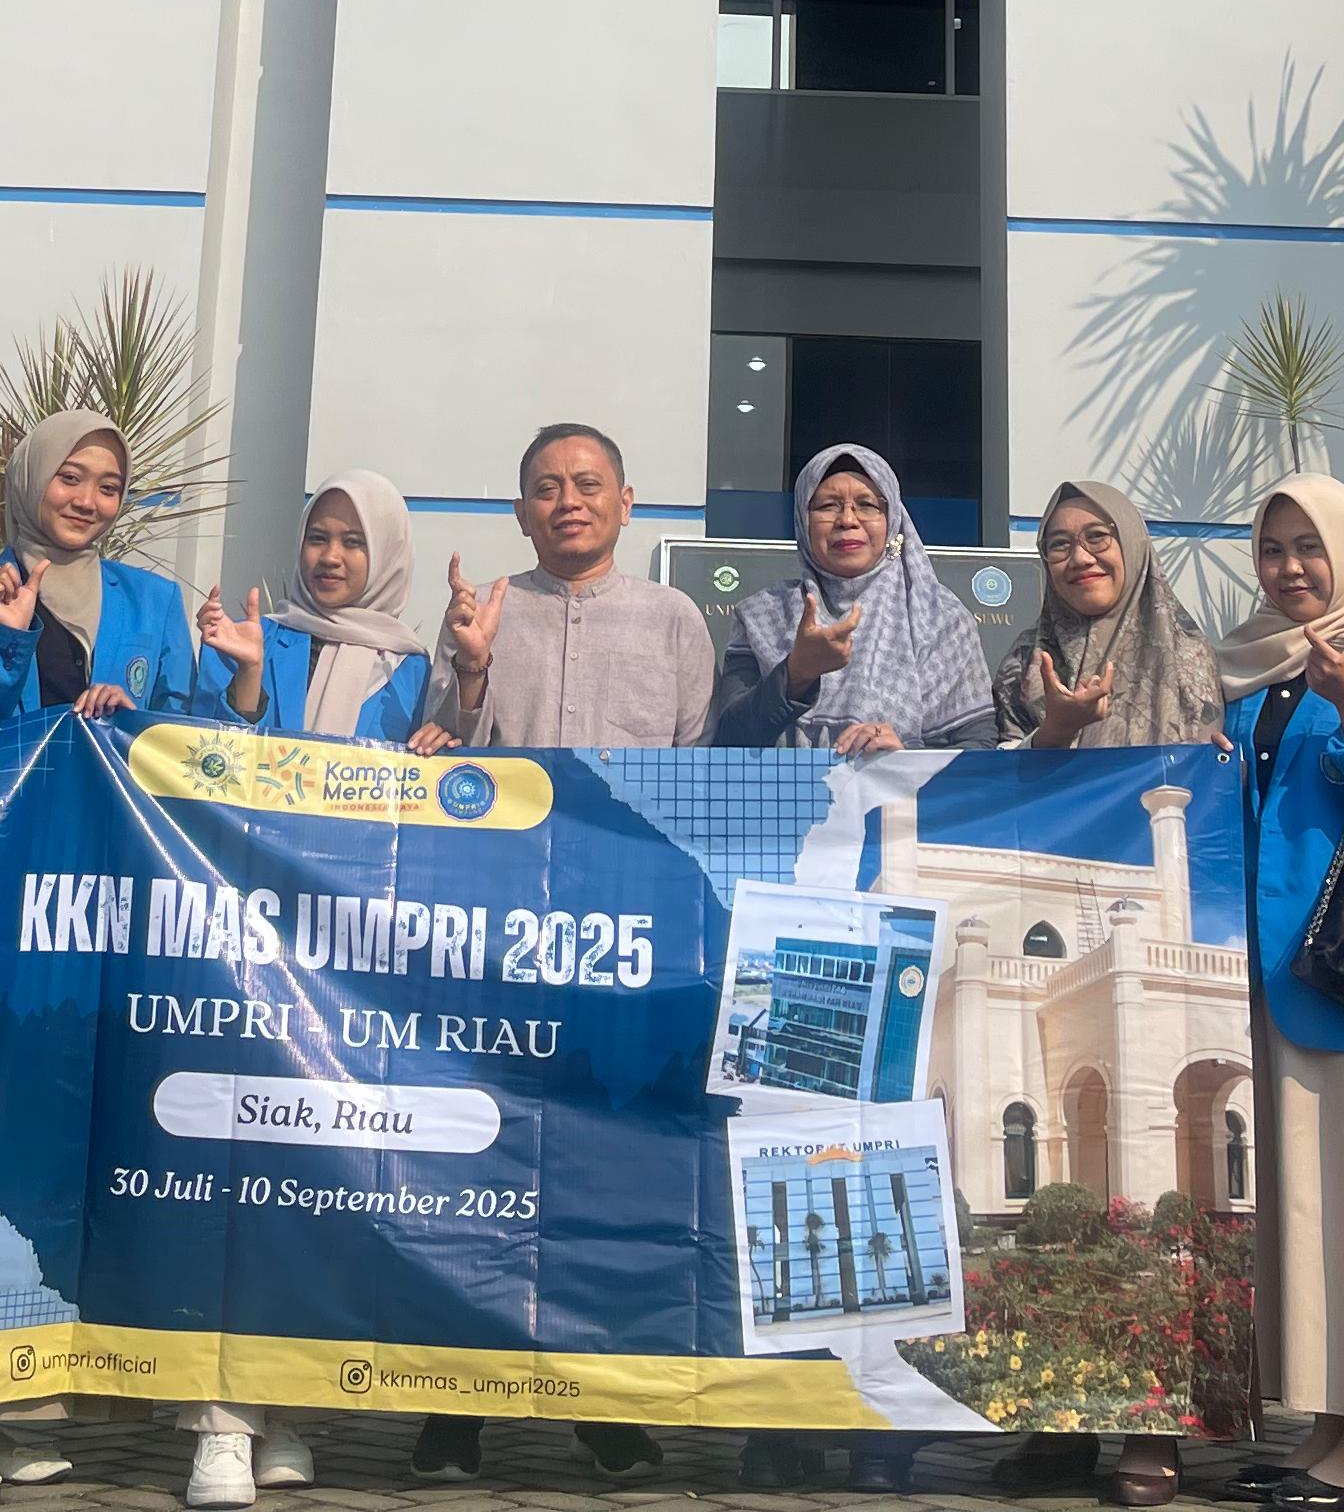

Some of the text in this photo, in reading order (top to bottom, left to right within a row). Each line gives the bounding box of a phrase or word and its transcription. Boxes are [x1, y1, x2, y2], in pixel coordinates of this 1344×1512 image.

[325, 761, 421, 786] Kampus
[323, 782, 428, 801] Merdeka
[19, 873, 653, 988] KKN MAS UMPRI 2025
[127, 993, 294, 1040] UMPRI
[340, 1008, 421, 1050] UM
[436, 1014, 562, 1058] RIAU
[237, 1094, 413, 1135] Siak, Riau
[853, 1139, 900, 1152] UMPRI
[109, 1168, 149, 1197] 30
[154, 1171, 214, 1202] Juli
[238, 1176, 271, 1205] 10
[277, 1178, 450, 1216] September
[455, 1188, 538, 1219] 2025
[42, 1350, 157, 1375] umpri.official
[380, 1370, 580, 1399] kknmas_umpri2025
